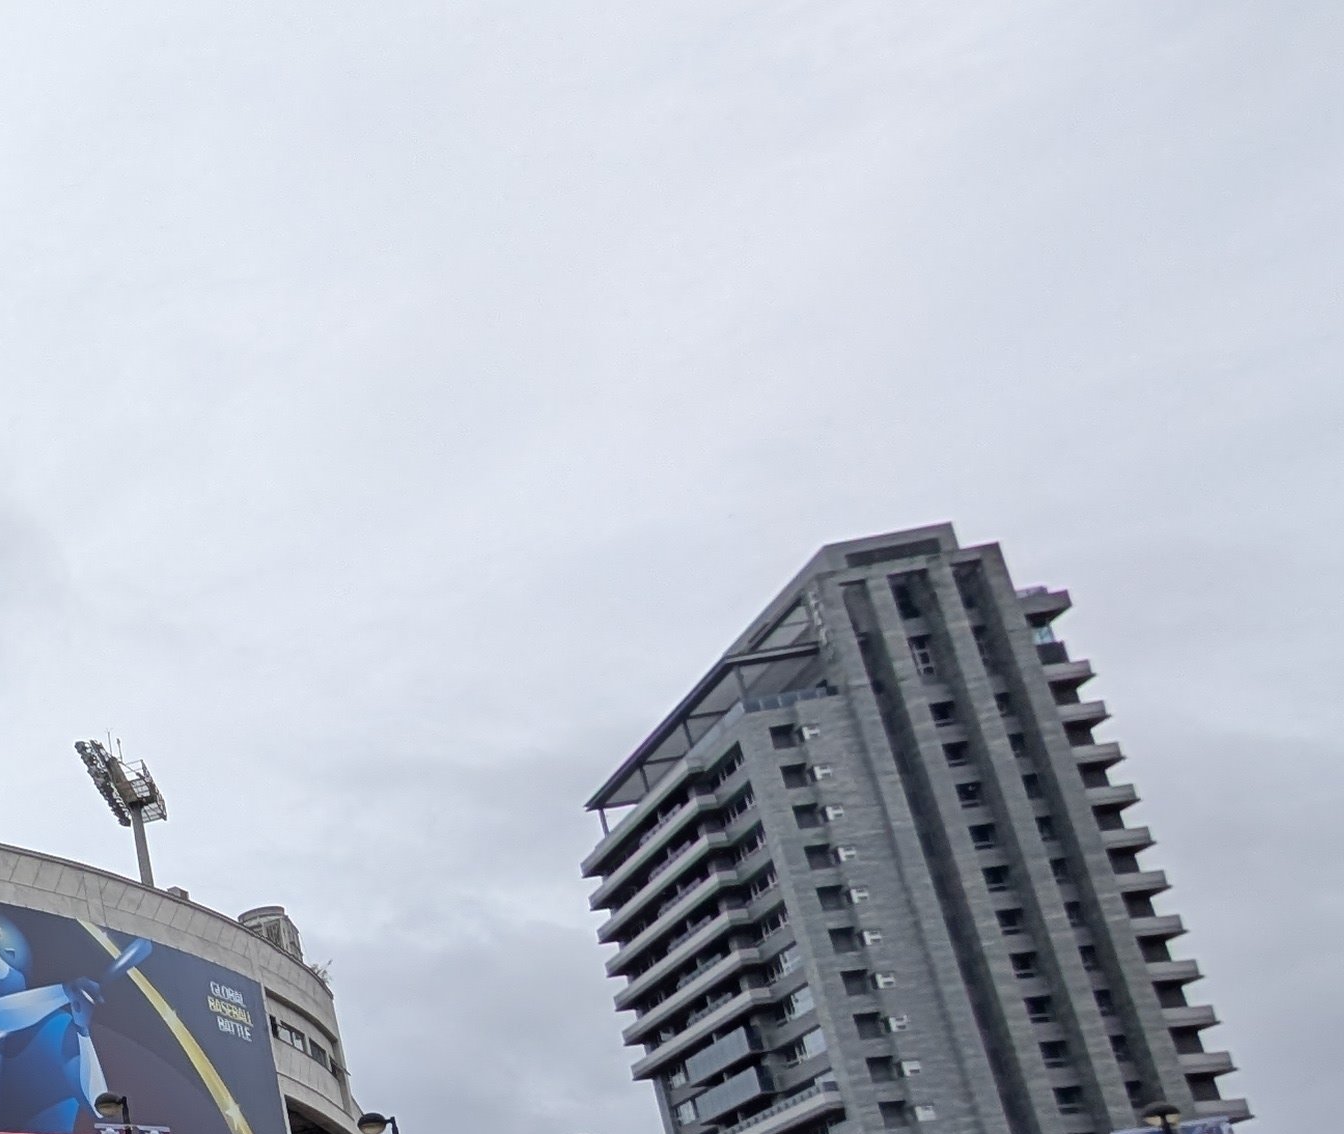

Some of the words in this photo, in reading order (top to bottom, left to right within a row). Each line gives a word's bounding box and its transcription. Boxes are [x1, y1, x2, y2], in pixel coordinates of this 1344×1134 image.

[210, 981, 247, 1008] GLOBAL
[207, 995, 254, 1028] BASEBALL
[217, 1015, 252, 1042] BATTLE
